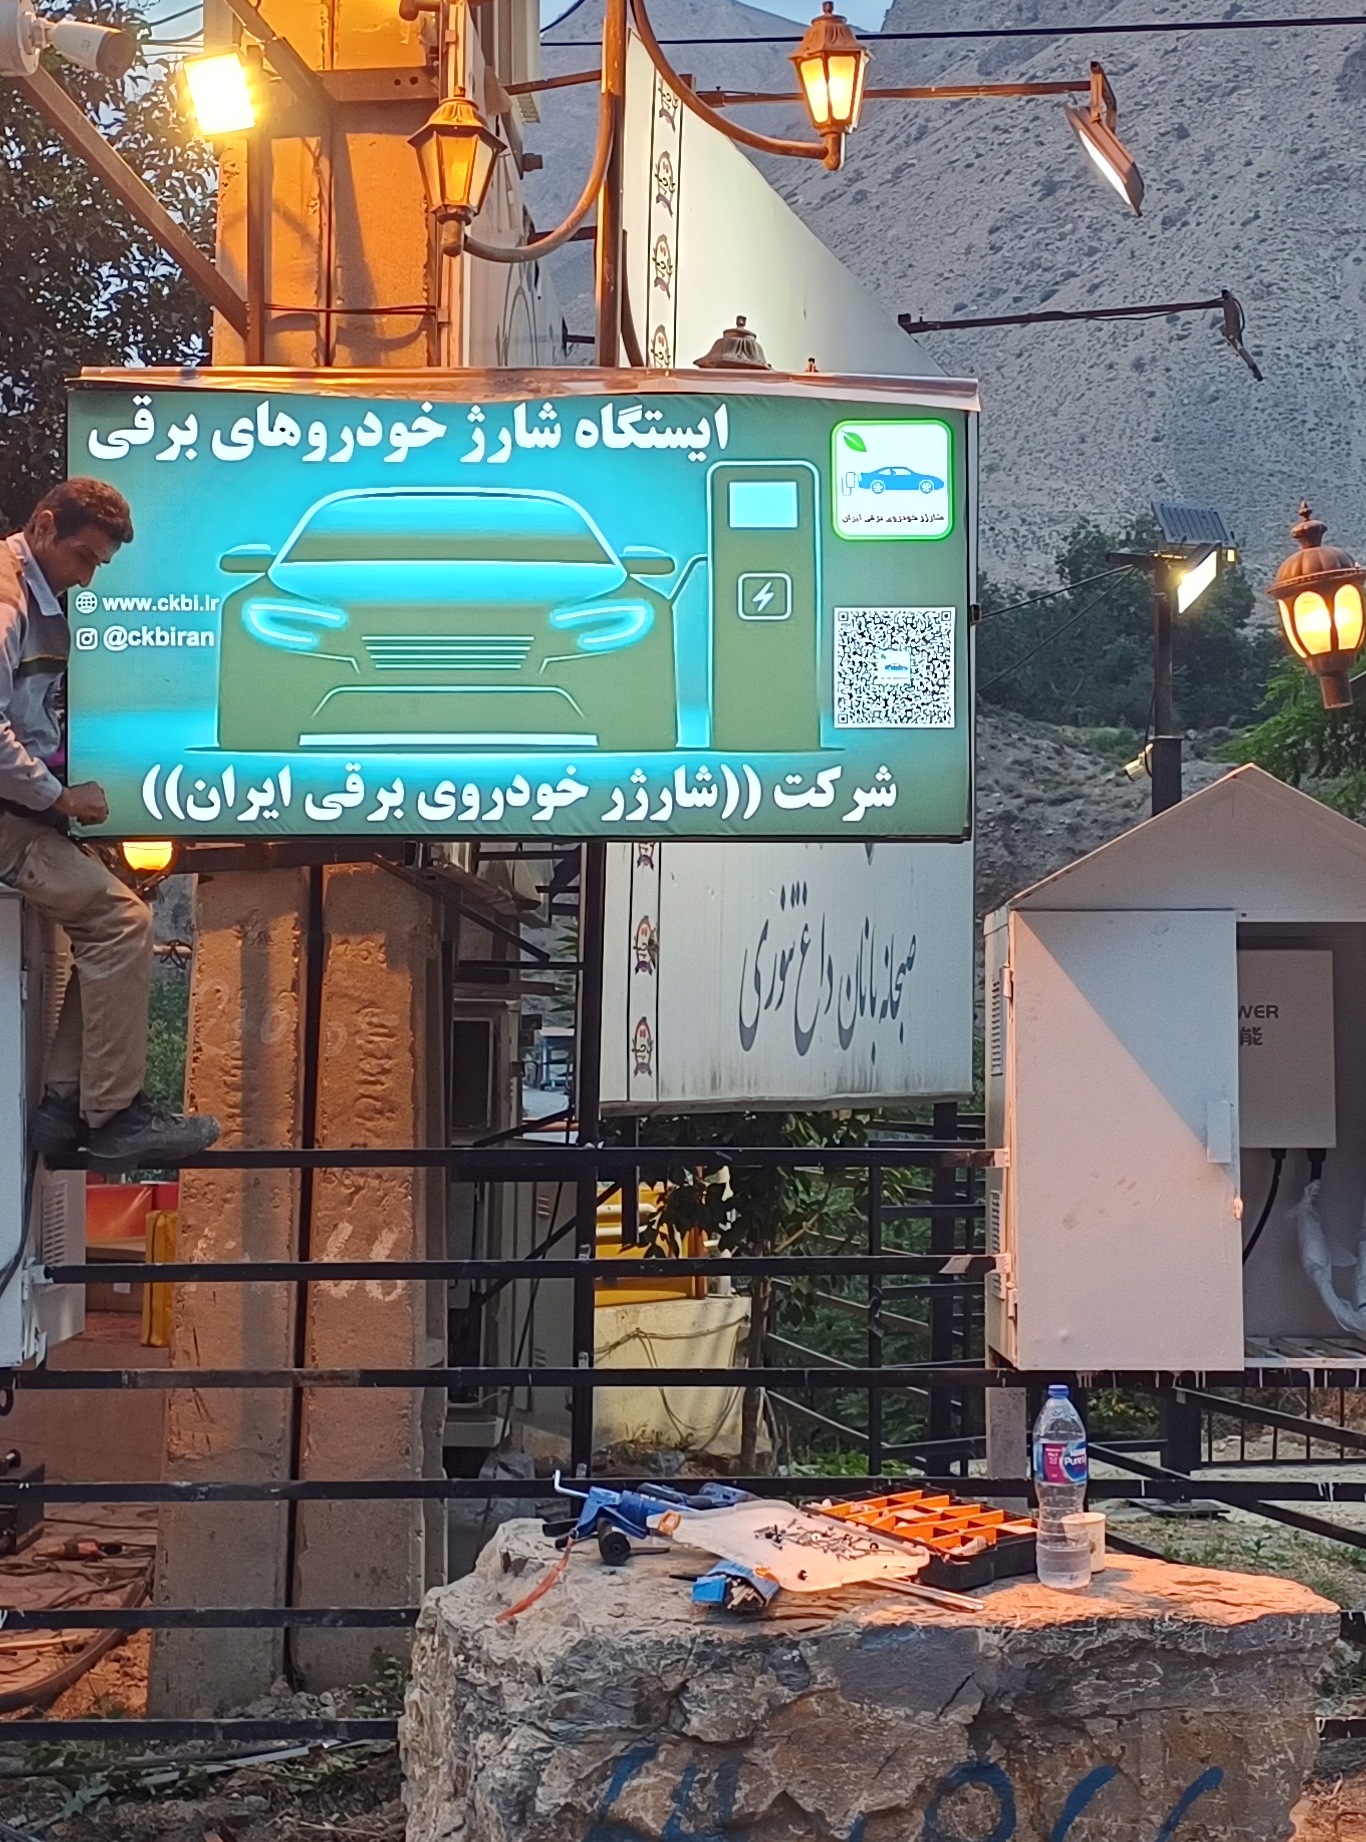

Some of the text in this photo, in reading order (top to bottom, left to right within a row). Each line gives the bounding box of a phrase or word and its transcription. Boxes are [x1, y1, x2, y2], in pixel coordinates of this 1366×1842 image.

[87, 394, 729, 464] ایستگاه شارژ خودروهای برقی
[102, 625, 215, 652] @ckbiran
[303, 761, 406, 822] برقی
[416, 763, 591, 822] خودروی
[773, 764, 898, 822] شرکت
